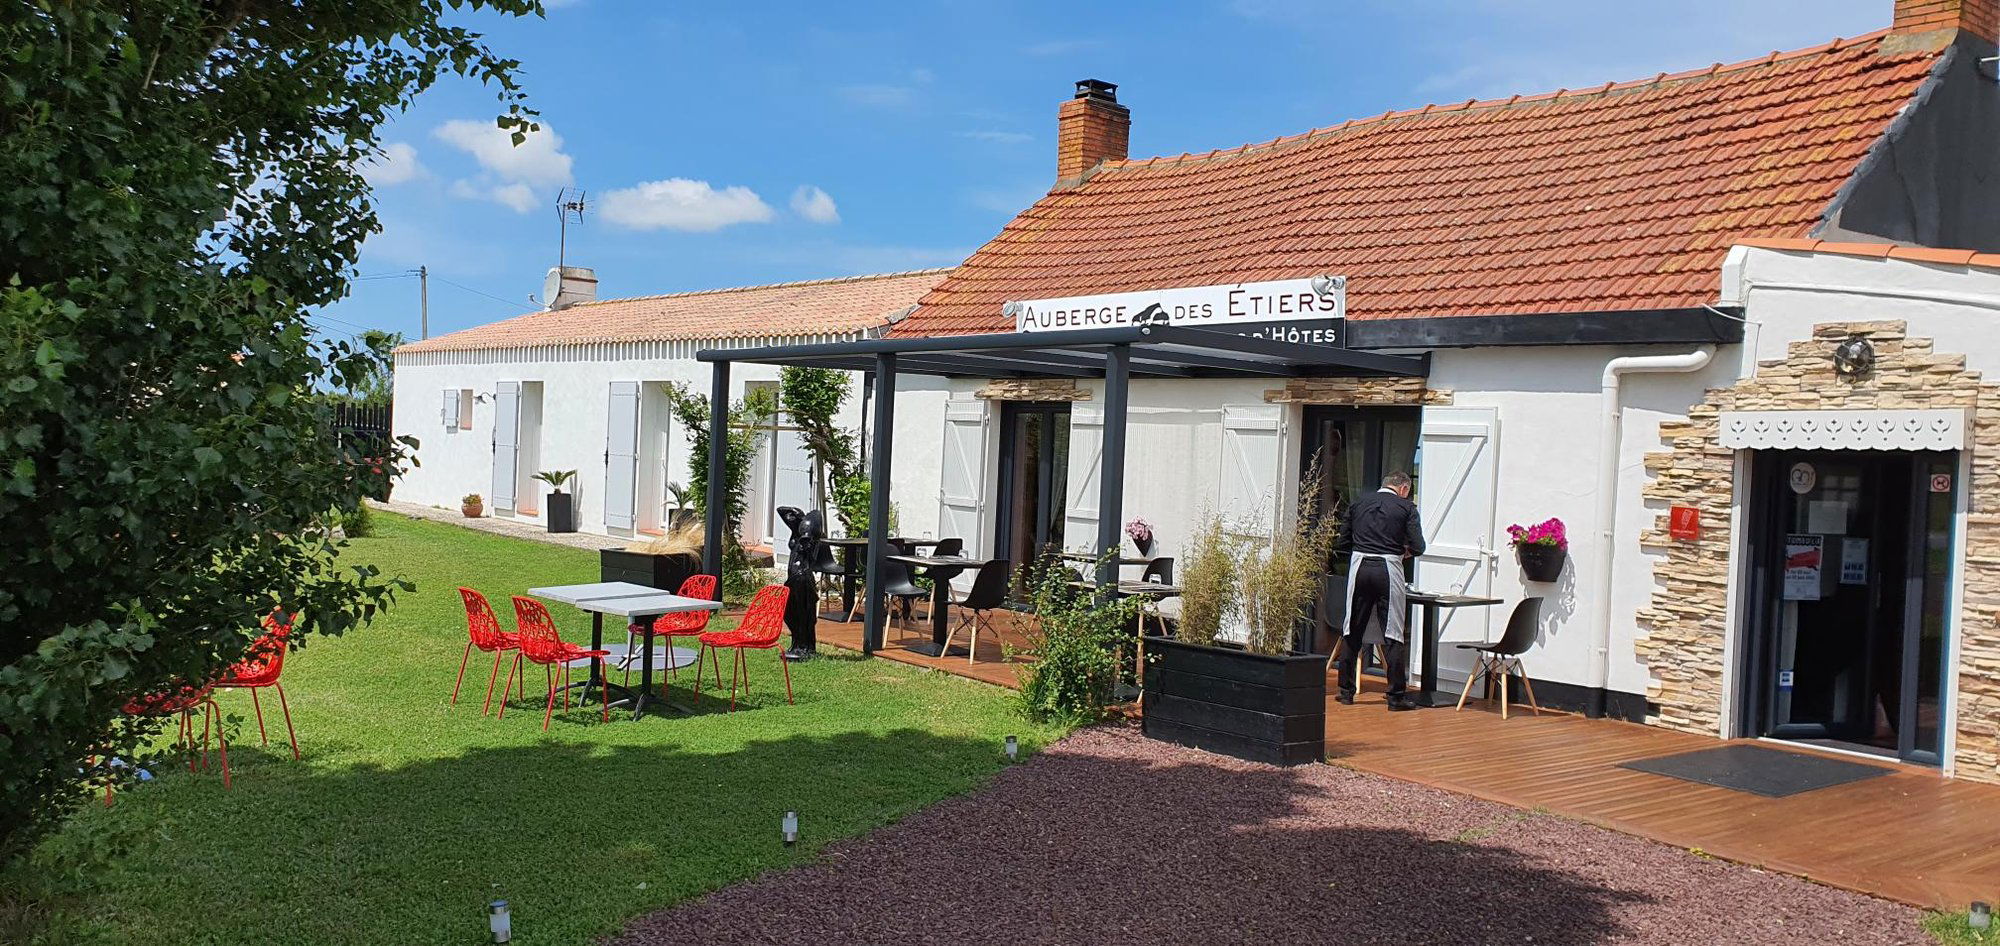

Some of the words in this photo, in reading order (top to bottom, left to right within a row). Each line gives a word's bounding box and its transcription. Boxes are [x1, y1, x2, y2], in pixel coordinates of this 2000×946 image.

[1022, 305, 1128, 328] AUBERGE
[1174, 304, 1213, 320] DES
[1228, 284, 1336, 317] ÉTIERS
